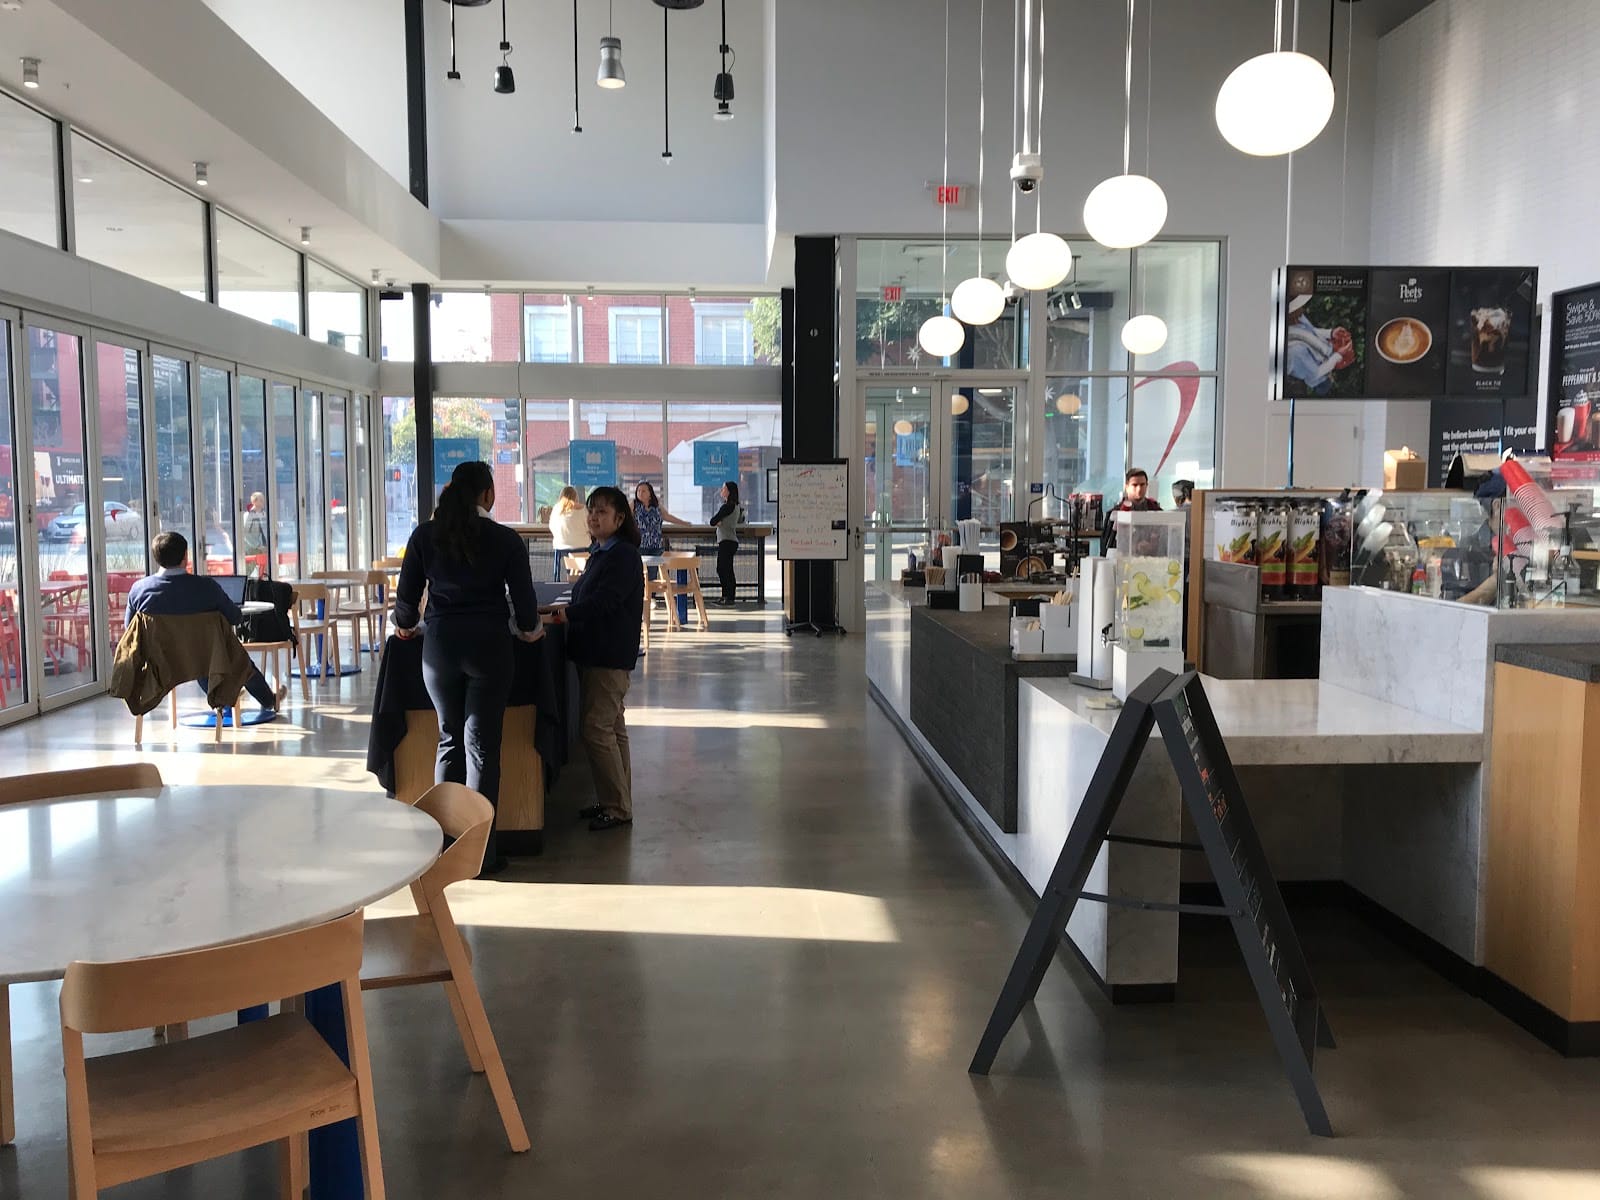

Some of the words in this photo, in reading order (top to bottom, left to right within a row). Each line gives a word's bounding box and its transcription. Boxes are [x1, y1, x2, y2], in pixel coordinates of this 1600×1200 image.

[938, 186, 959, 204] EXIT
[884, 286, 901, 302] EXIT
[1566, 302, 1588, 314] Swipe
[1589, 299, 1595, 310] &
[1566, 312, 1583, 326] Save
[1562, 372, 1592, 387] PEPPERMINT
[1592, 371, 1597, 383] &
[1442, 431, 1450, 440] We
[1451, 430, 1468, 440] believe
[1468, 428, 1488, 440] banking
[1514, 427, 1528, 438] your
[1451, 441, 1459, 451] the
[1460, 441, 1472, 451] other
[1473, 442, 1484, 451] way
[55, 475, 84, 485] ULTIMATE
